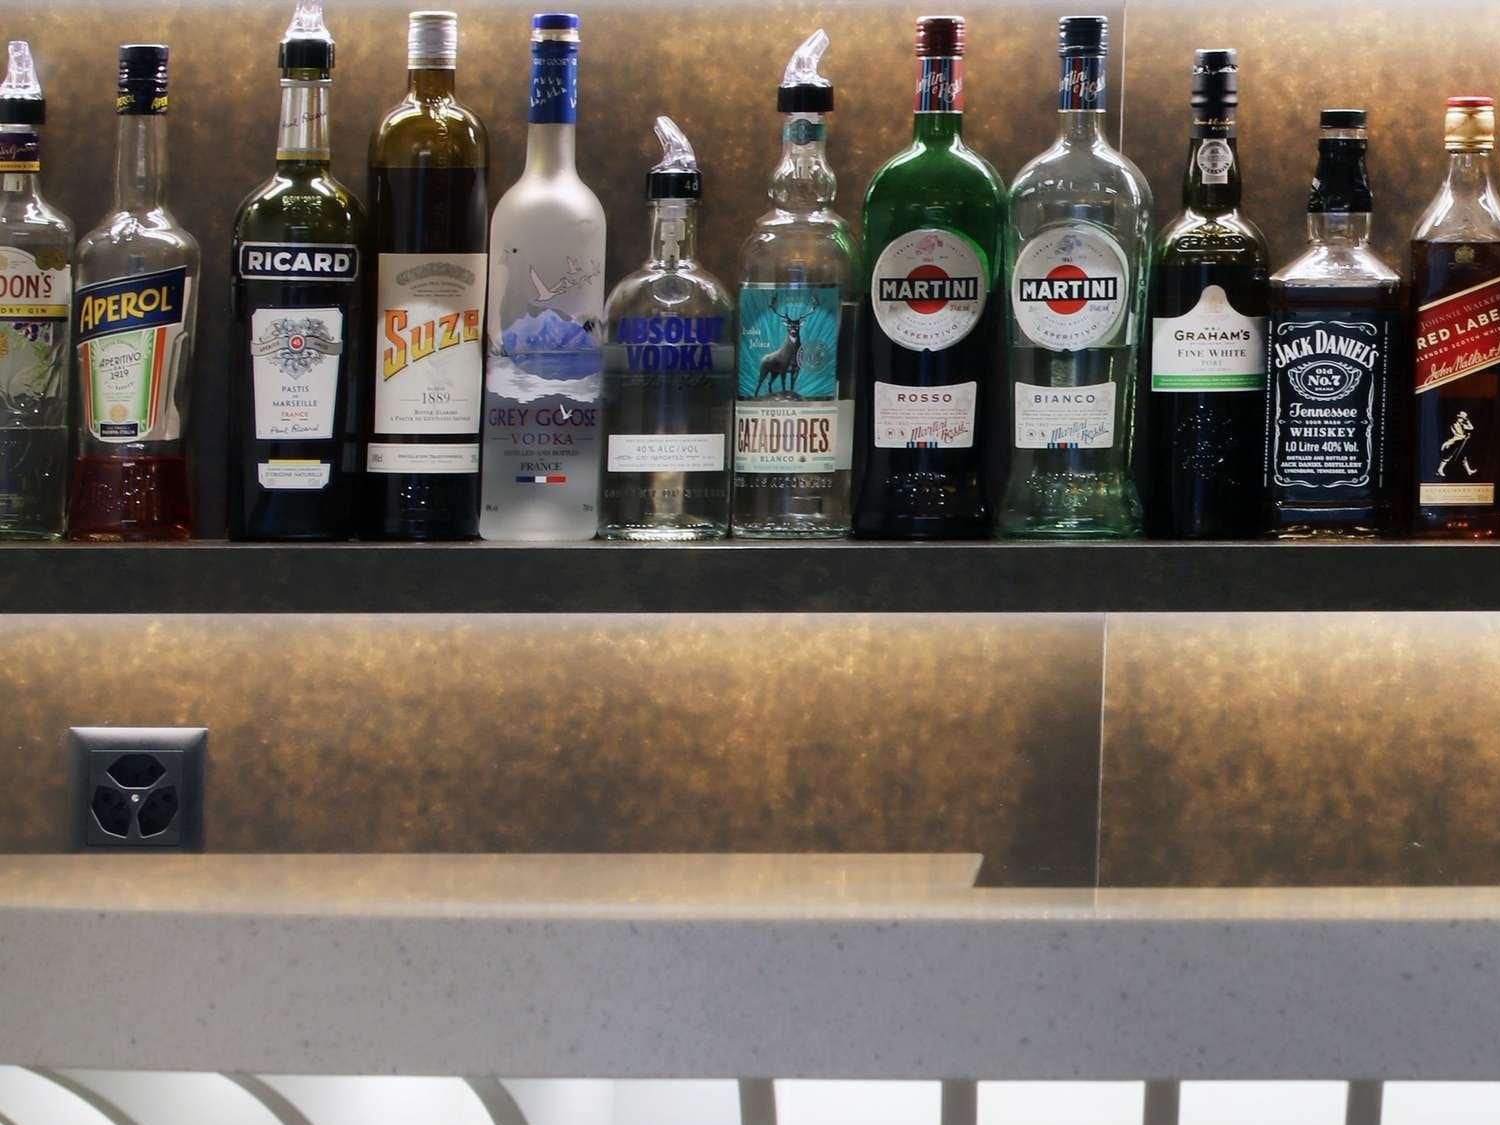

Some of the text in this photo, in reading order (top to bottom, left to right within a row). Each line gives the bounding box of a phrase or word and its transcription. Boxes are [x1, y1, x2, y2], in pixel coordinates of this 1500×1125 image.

[248, 250, 350, 273] RICARD
[881, 279, 975, 300] MARTINI
[1021, 279, 1115, 300] MARTINI
[80, 286, 173, 333] APEROL
[616, 317, 724, 344] ABSOLUT
[1174, 329, 1251, 341] GRAHAM'S
[1416, 328, 1451, 350] RED
[1177, 348, 1247, 358] FINE WHITE
[1275, 329, 1379, 370] JACK DANIEL'S
[626, 344, 715, 372] VODKA
[281, 385, 310, 393] PASTIS
[272, 400, 318, 408] MARSEILLE
[897, 393, 953, 403] ROSSO
[1034, 394, 1096, 404] BIANCO
[761, 408, 797, 417] TEQUILA
[1289, 402, 1358, 418] Tennessee
[488, 407, 527, 427] GREY
[535, 407, 597, 427] GOOSE
[737, 417, 831, 453] CAZADORES
[1290, 427, 1356, 437] WHISKEY
[511, 433, 575, 445] VODKA
[1298, 441, 1320, 452] Litre
[1321, 441, 1342, 452] 40%
[1343, 441, 1359, 452] Vol.
[760, 455, 795, 463] BLANCO
[520, 461, 563, 471] FRANCE
